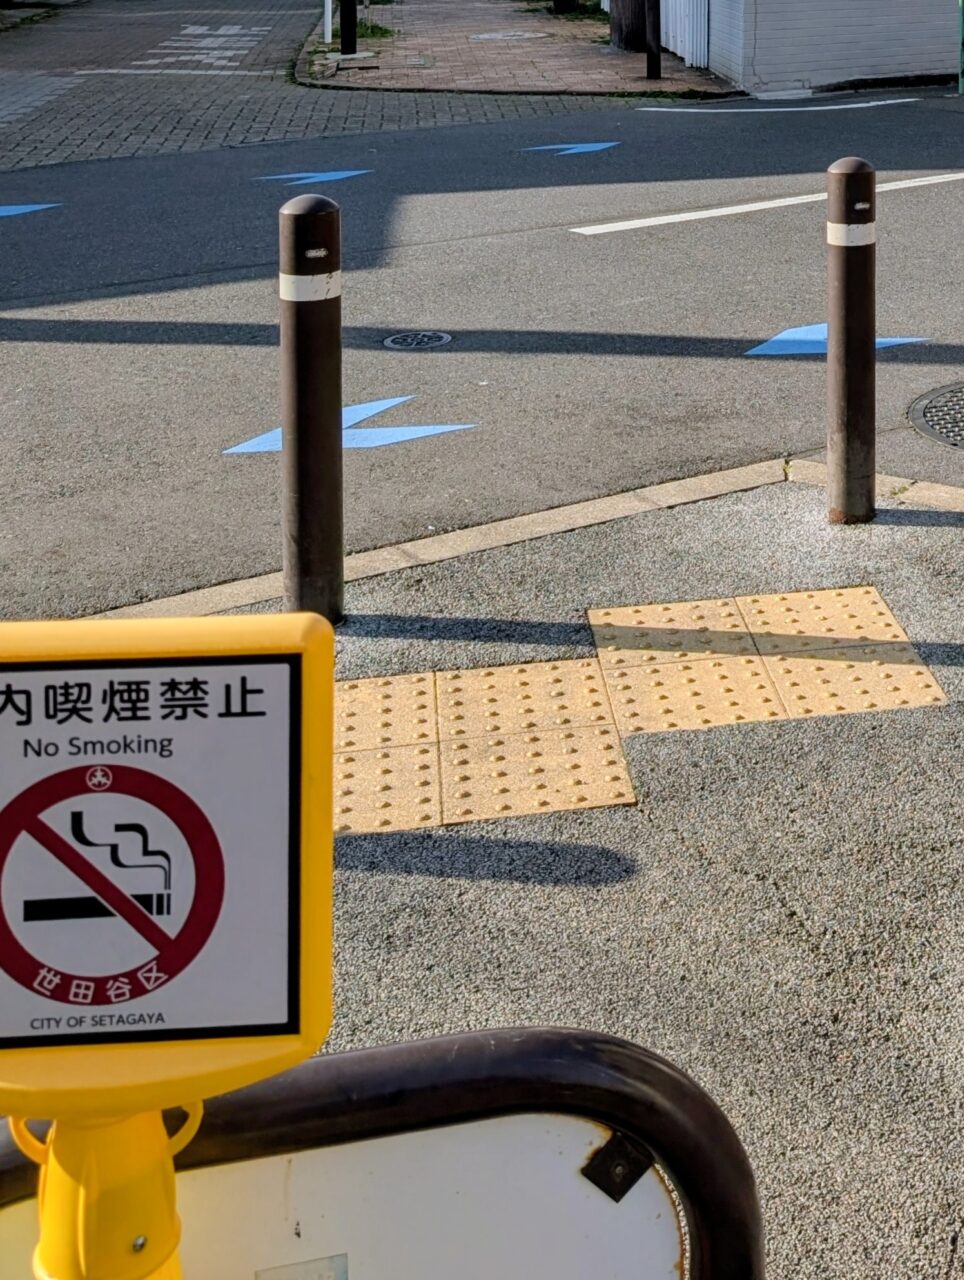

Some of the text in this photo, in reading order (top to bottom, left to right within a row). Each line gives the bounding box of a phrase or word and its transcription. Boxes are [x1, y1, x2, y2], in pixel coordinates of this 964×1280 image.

[23, 734, 174, 758] No Smoking
[33, 960, 169, 1004] 世田谷区
[30, 1013, 166, 1030] CITY OF SETAGAYA
